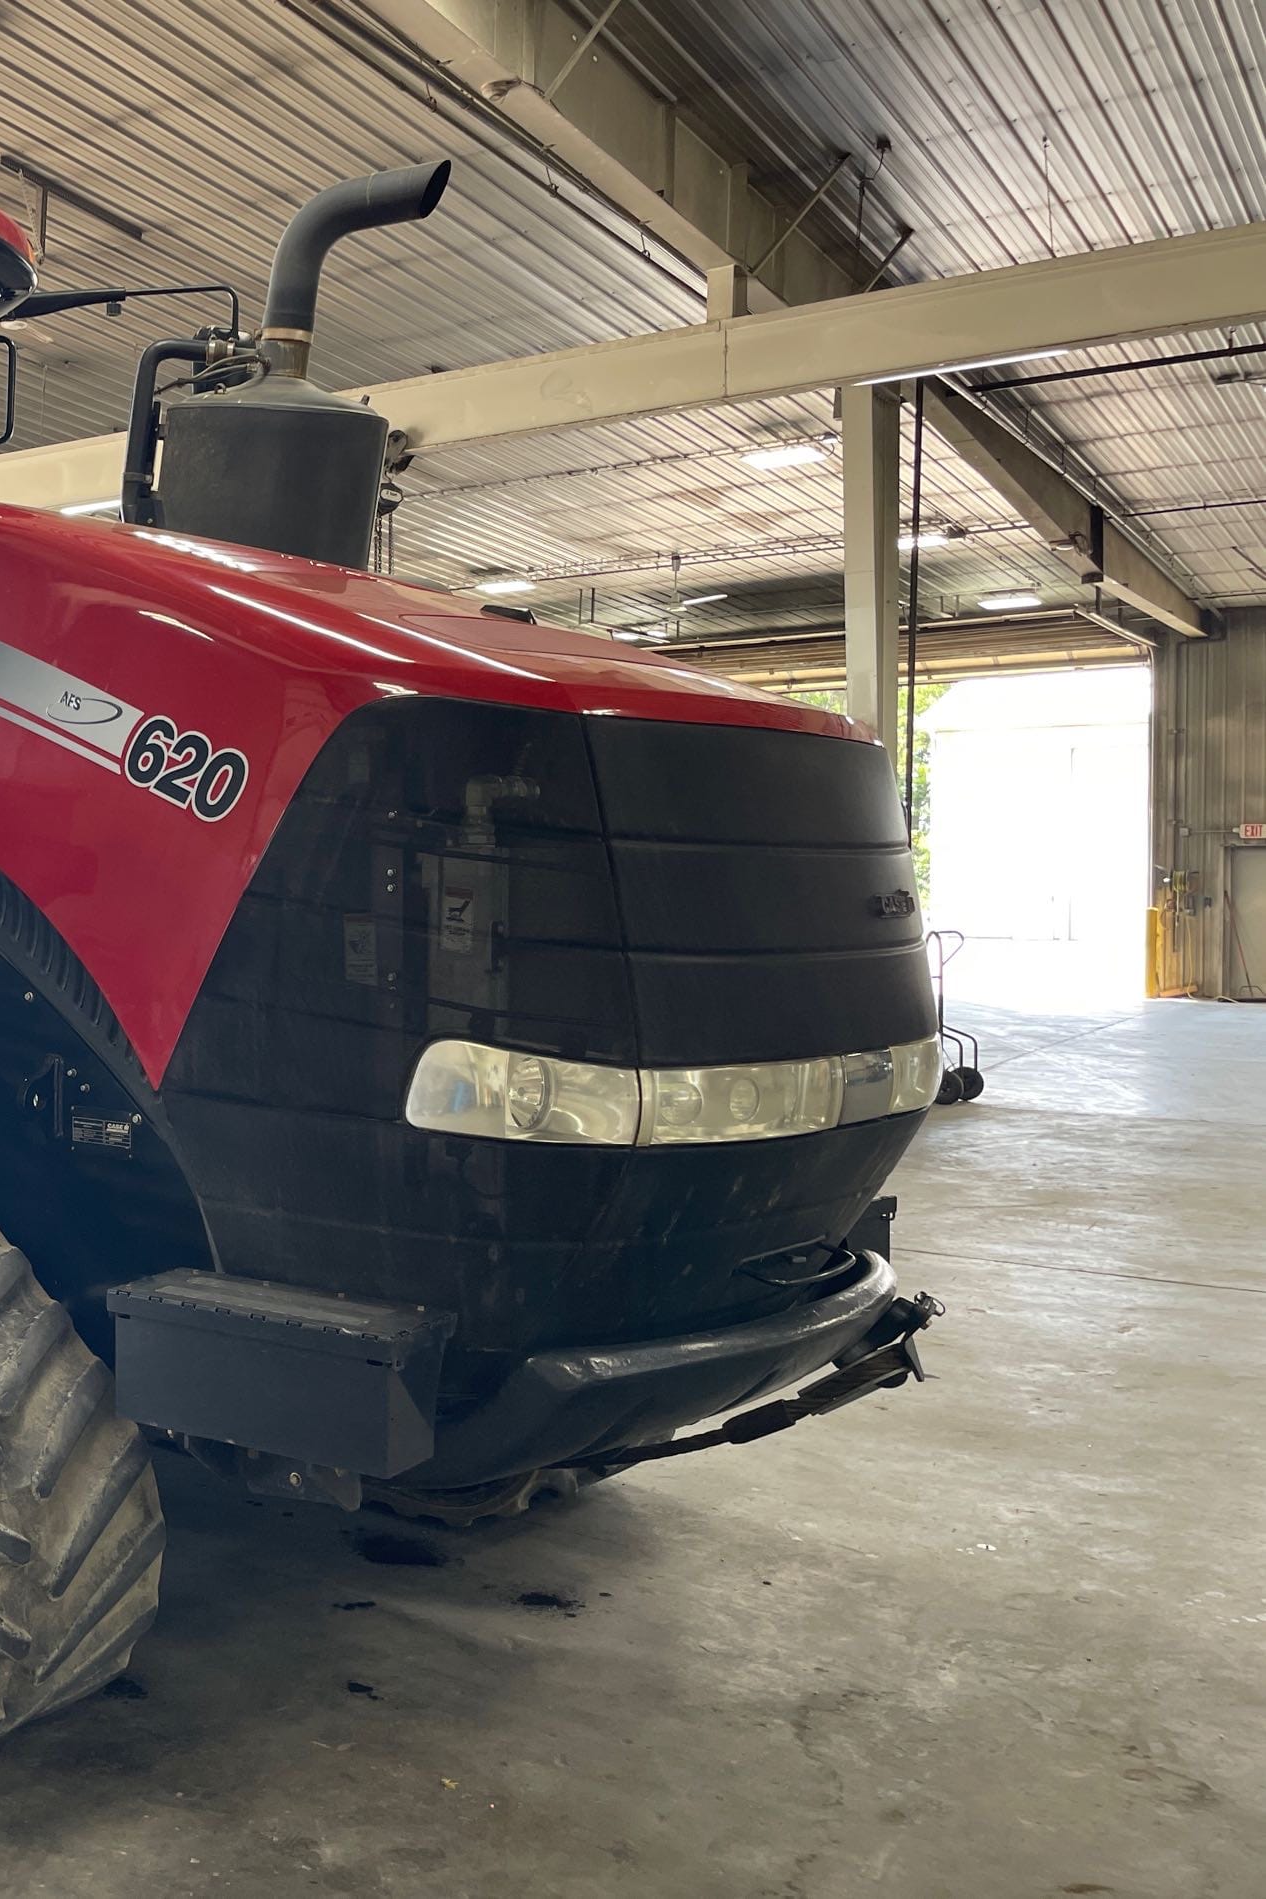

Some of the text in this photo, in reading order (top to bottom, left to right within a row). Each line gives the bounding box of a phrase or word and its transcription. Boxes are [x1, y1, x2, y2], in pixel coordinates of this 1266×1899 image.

[59, 690, 82, 711] AFS
[125, 716, 249, 823] 620
[1245, 825, 1262, 837] EXIT
